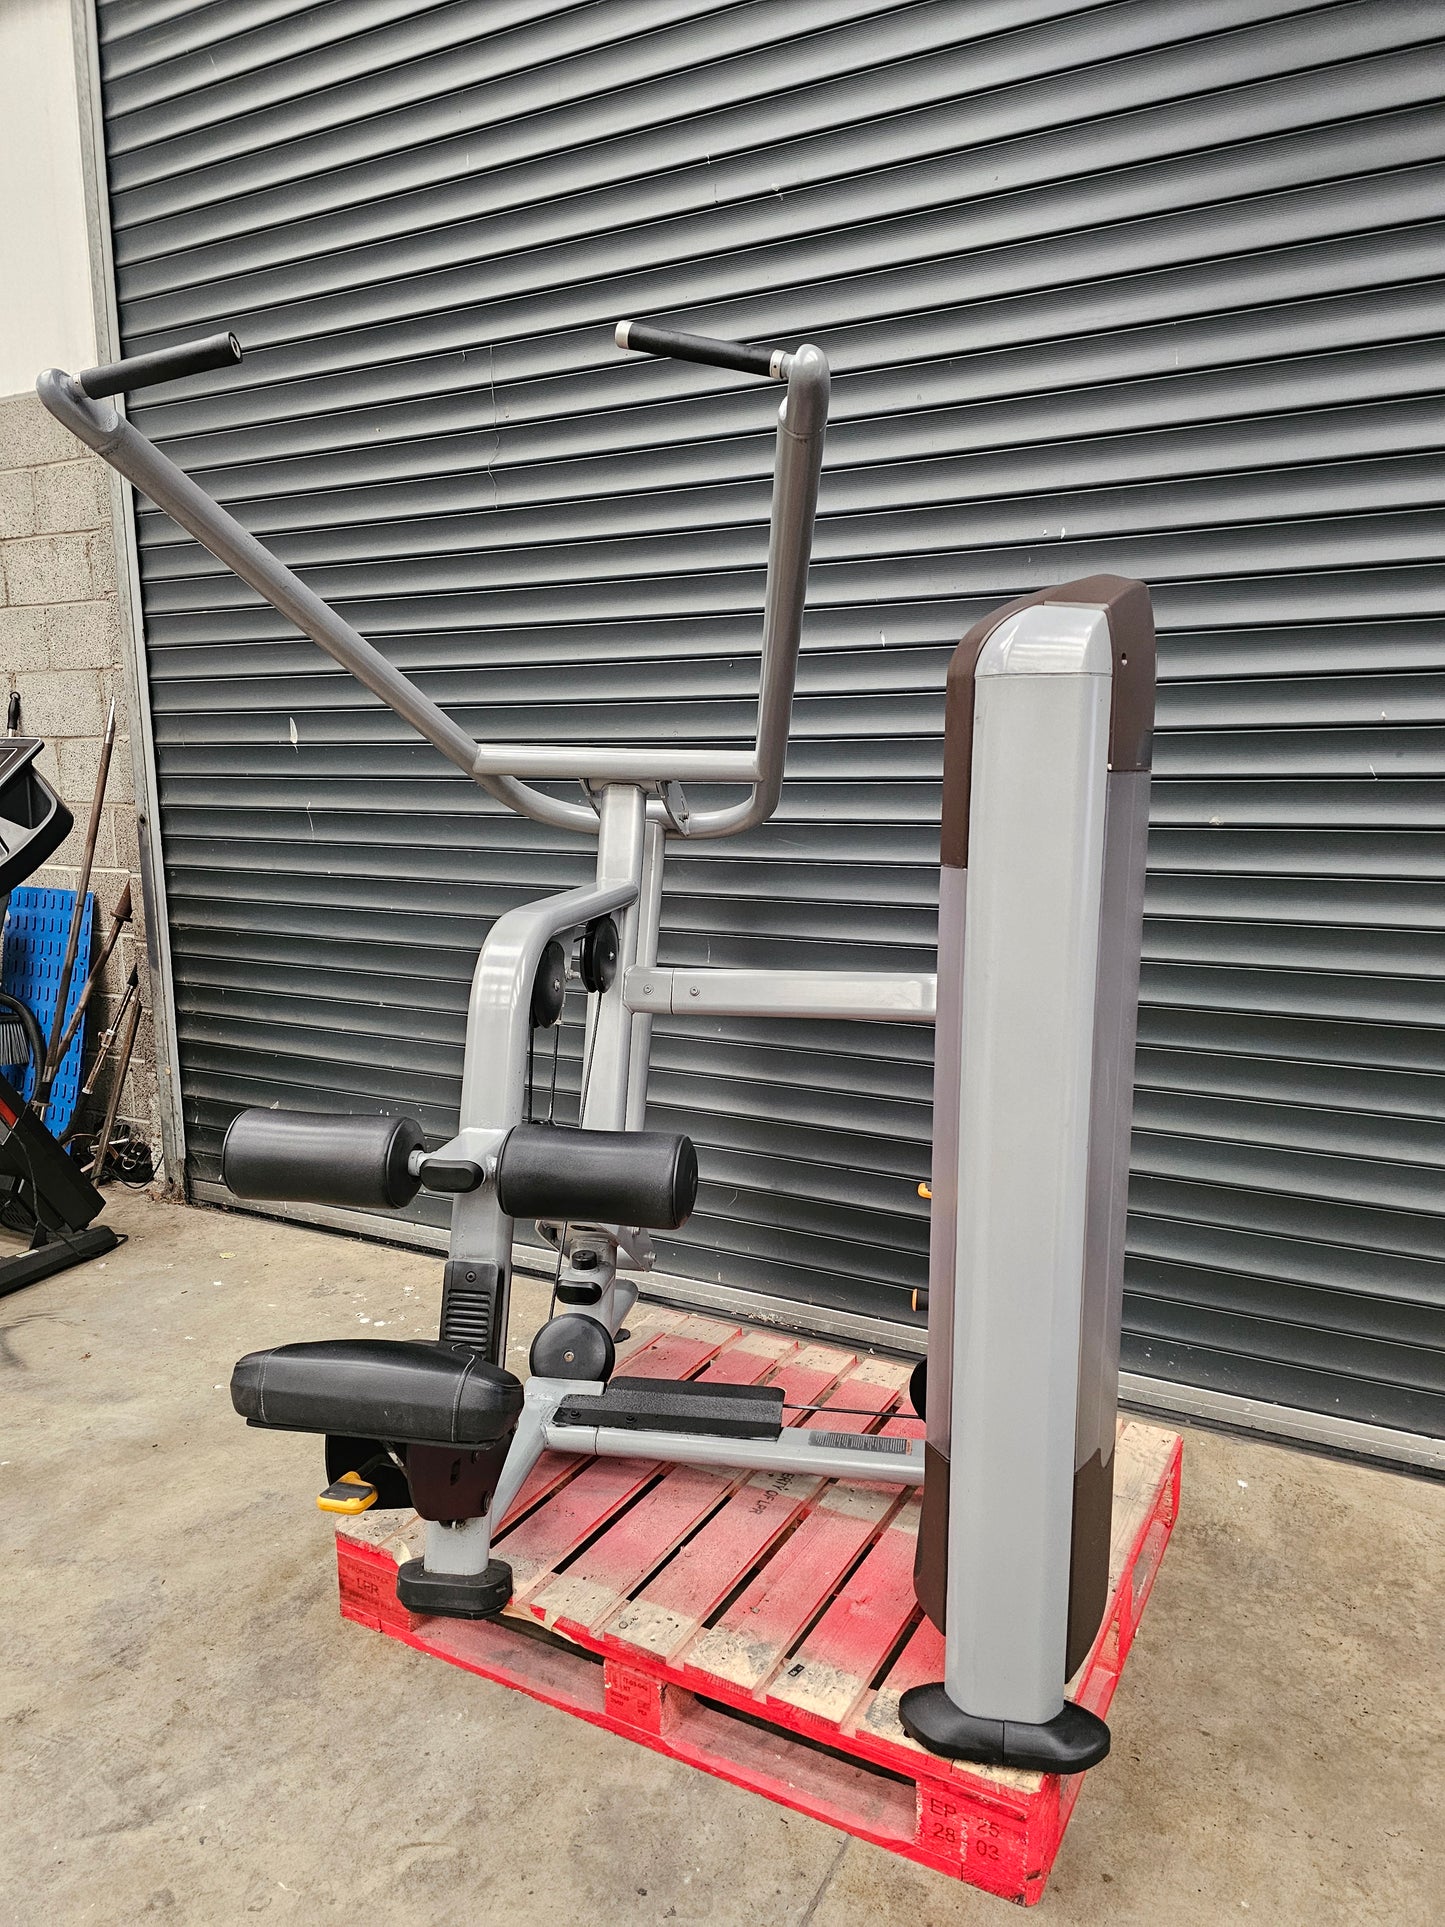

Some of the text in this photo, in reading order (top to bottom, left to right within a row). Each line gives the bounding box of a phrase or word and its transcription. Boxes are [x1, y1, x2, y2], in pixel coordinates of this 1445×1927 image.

[772, 1472, 795, 1491] ERTY
[749, 1500, 770, 1514] LPR
[930, 1797, 1000, 1838] EP 25
[933, 1822, 1000, 1860] 28 03
